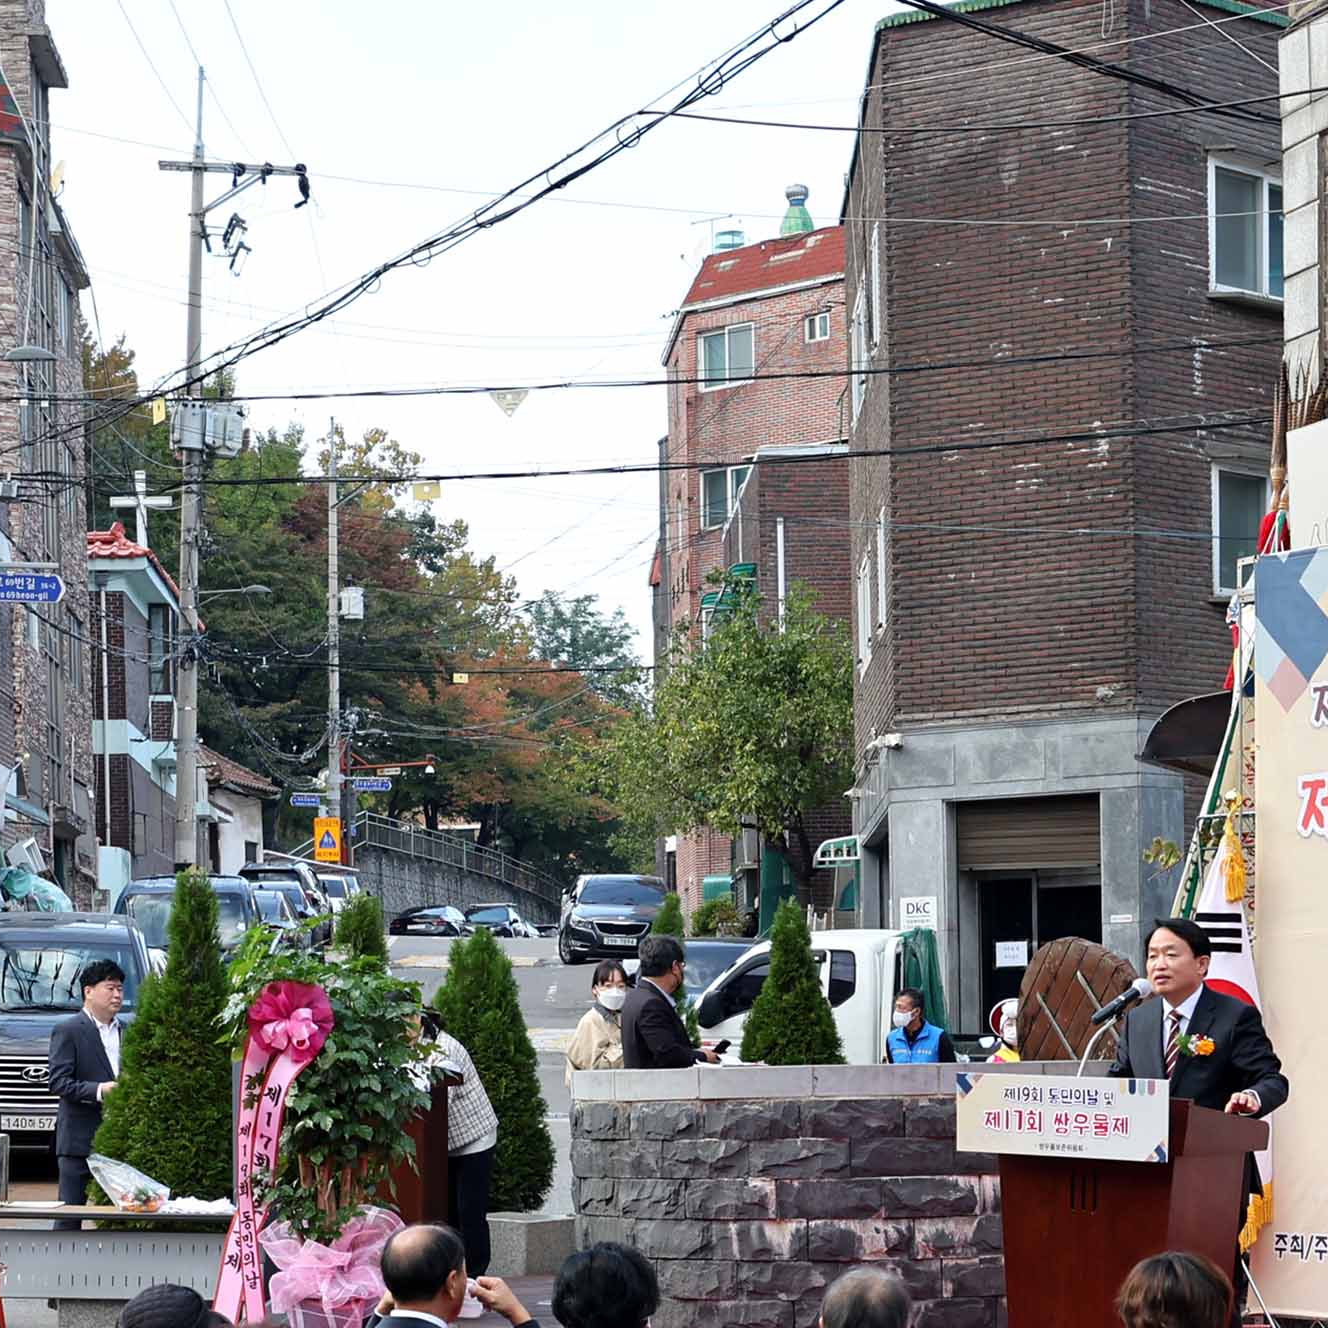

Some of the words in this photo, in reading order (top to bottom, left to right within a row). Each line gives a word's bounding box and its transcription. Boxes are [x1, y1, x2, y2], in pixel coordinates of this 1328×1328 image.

[1003, 1086, 1043, 1103] 제19회
[1047, 1088, 1099, 1105] 동민의날
[984, 1109, 1043, 1133] 제17회
[1052, 1113, 1130, 1137] 쌍우물제
[240, 1210, 260, 1290] 동민의날
